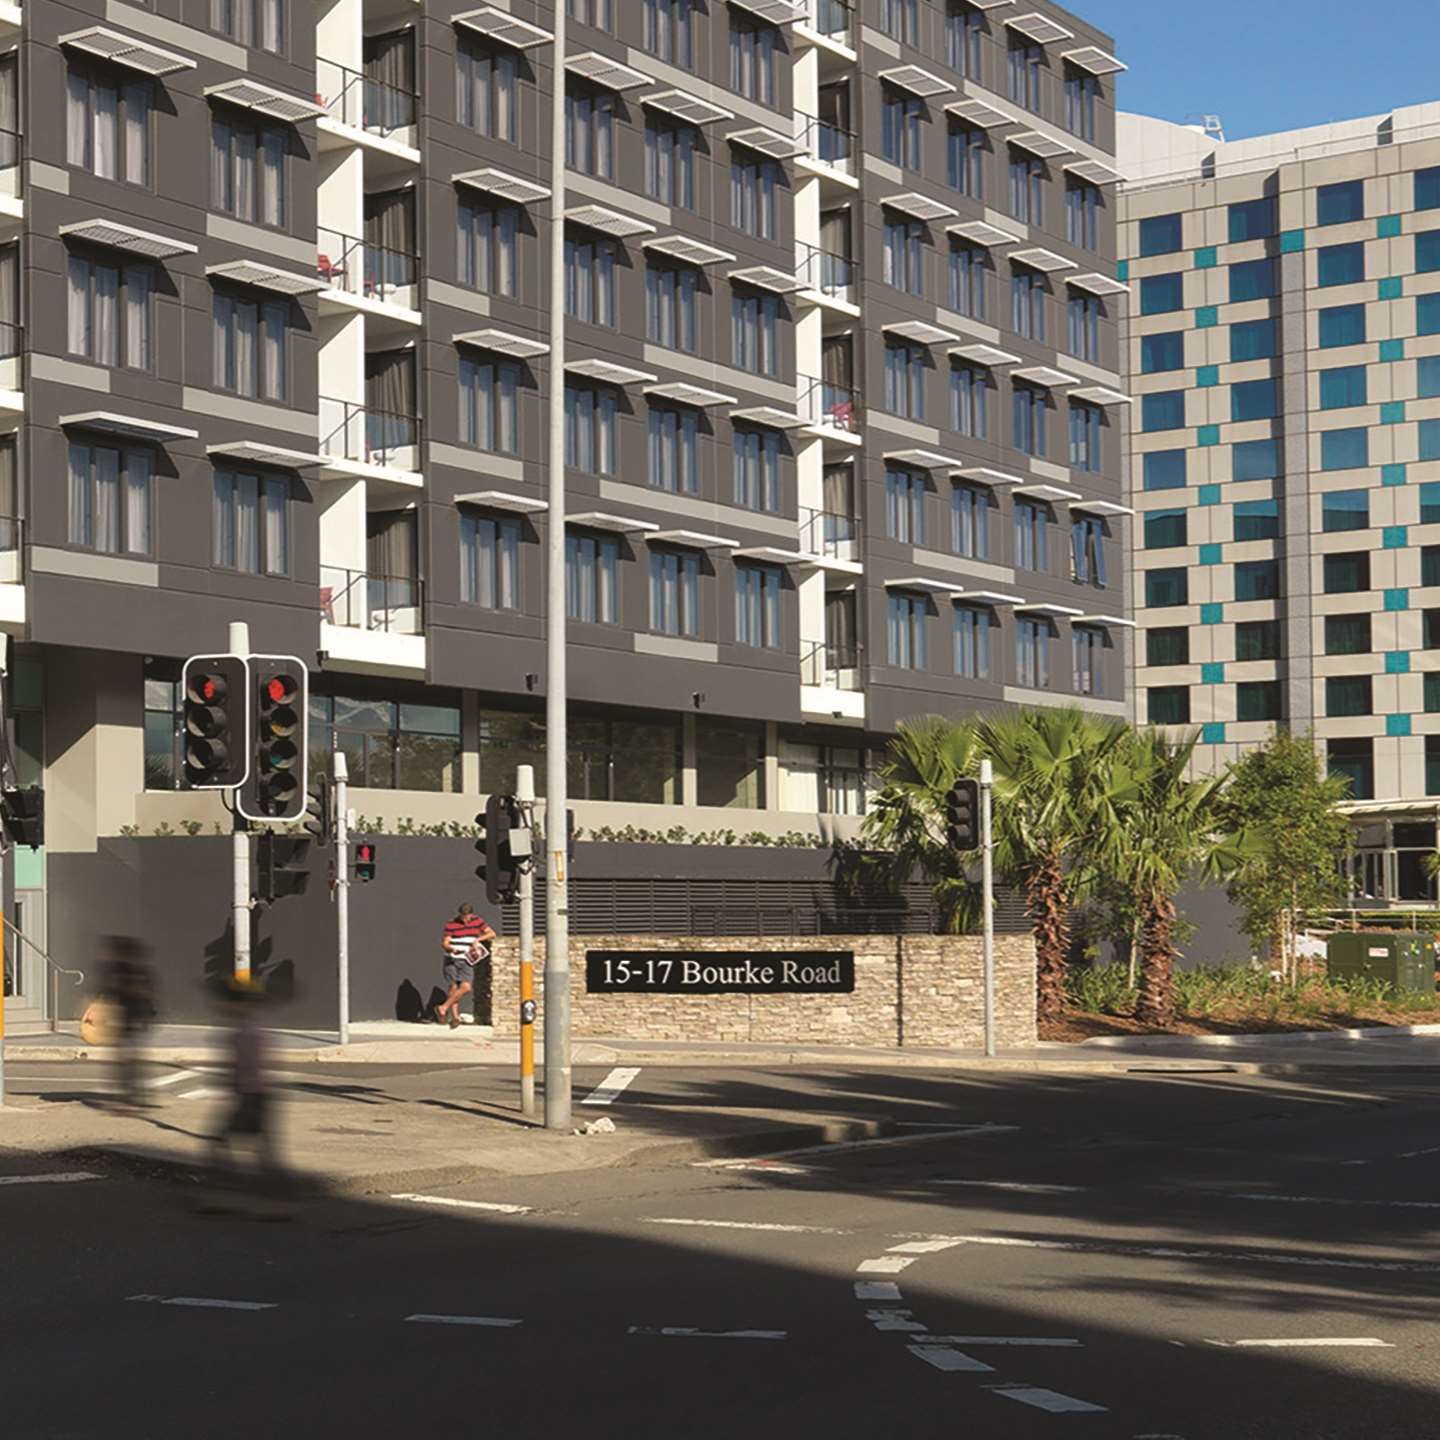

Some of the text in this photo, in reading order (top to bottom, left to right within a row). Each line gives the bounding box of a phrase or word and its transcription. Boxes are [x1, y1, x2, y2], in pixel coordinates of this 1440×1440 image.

[603, 959, 841, 984] 15-17 Bourke Road
